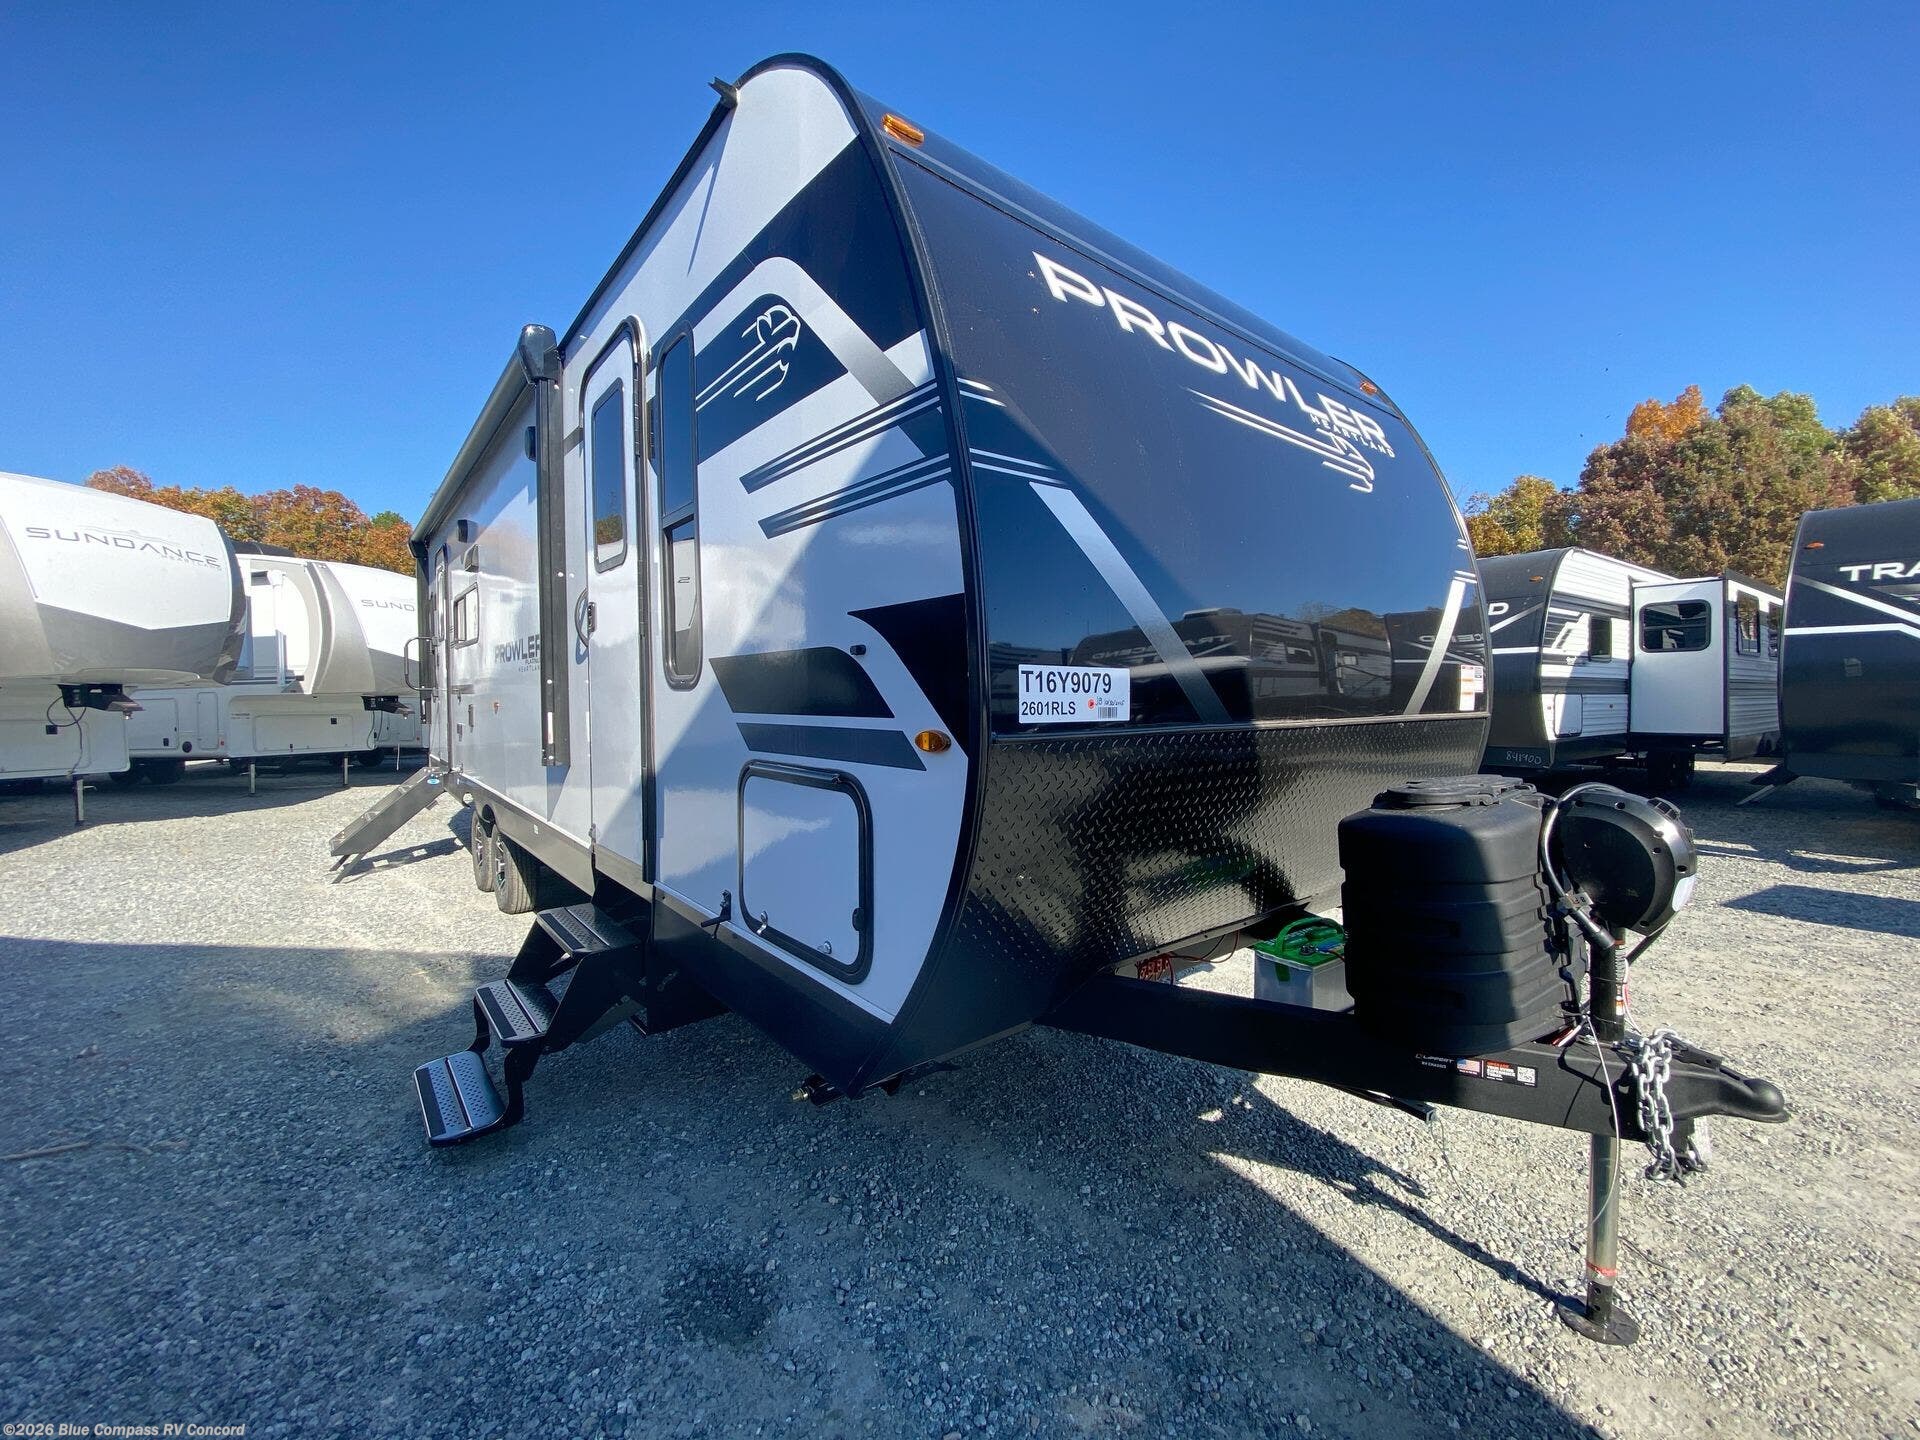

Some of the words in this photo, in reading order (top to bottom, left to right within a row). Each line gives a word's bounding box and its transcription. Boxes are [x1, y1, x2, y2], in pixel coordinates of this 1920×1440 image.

[1032, 250, 1394, 450] PROWLER
[1310, 413, 1396, 459] HEARTLAND
[25, 527, 221, 568] SUNDANCE
[361, 599, 415, 612] SUND
[1021, 670, 1112, 694] T16Y9079
[1021, 701, 1076, 716] 2601RLS
